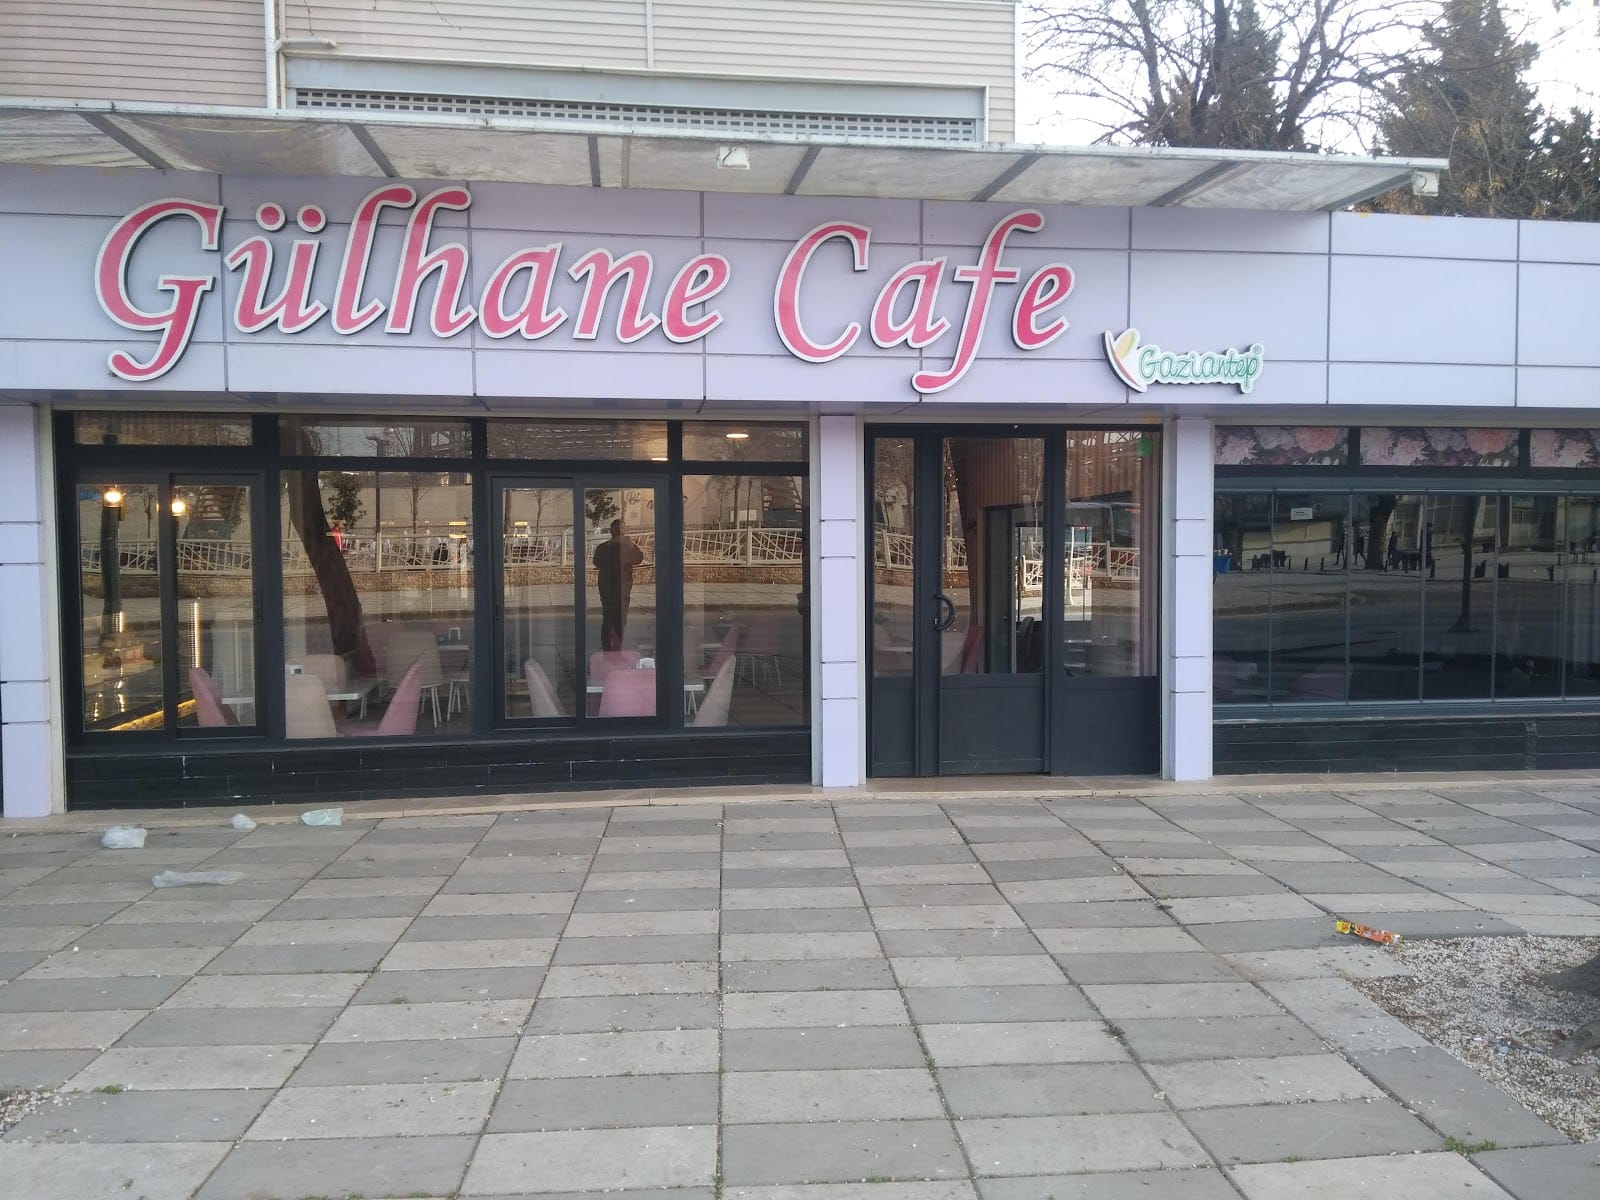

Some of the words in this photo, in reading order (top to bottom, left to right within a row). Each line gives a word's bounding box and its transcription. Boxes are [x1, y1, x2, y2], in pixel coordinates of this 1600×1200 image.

[95, 184, 730, 381] Gülhane
[774, 208, 1076, 393] Cafe
[1139, 347, 1262, 391] Gaziantep
